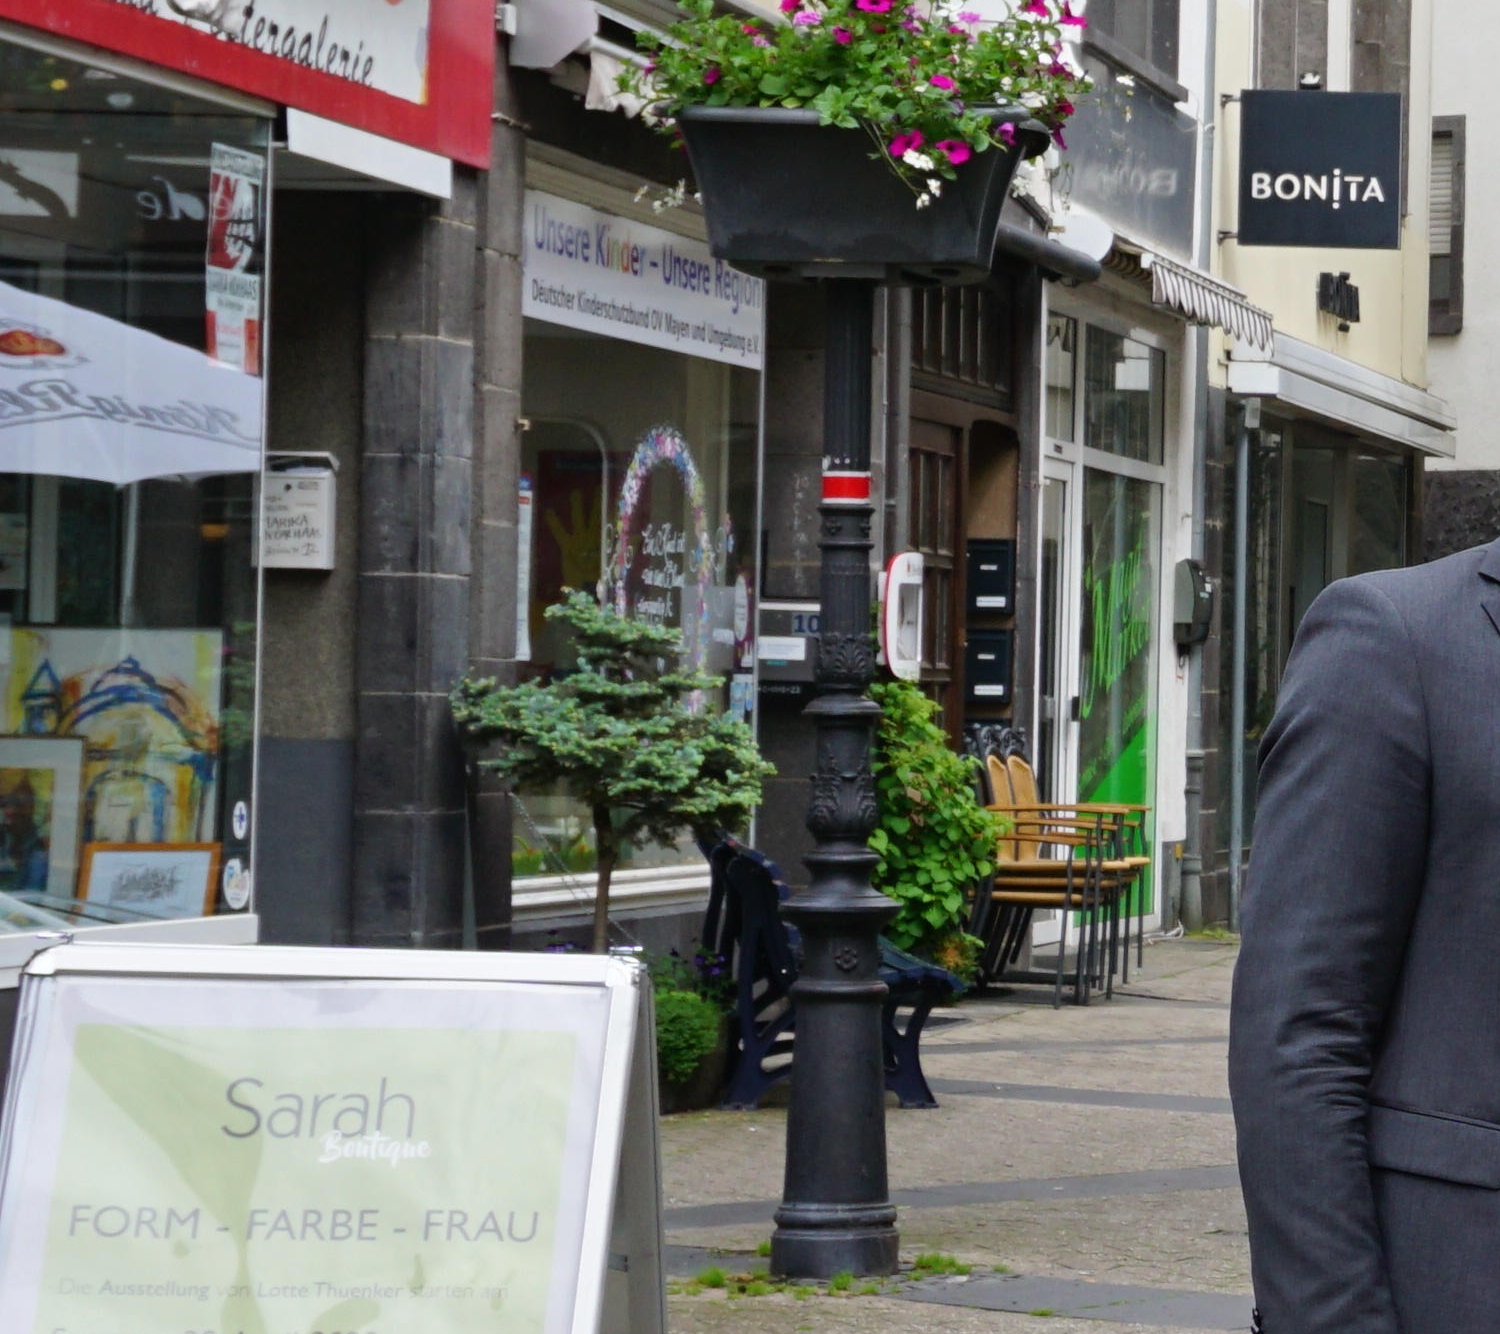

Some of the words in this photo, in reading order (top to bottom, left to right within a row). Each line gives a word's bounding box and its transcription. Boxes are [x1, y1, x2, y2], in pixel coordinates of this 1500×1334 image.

[533, 203, 591, 264] Unsere
[595, 222, 647, 278] Kinder
[661, 243, 710, 297] Unsere
[713, 259, 761, 316] Region
[531, 278, 575, 311] Deutscher
[576, 290, 650, 330] Kinderschutzbund
[651, 313, 663, 332] OV
[664, 314, 691, 342] Mayen
[692, 321, 706, 342] und
[707, 323, 747, 357] Umgebung
[221, 1077, 415, 1139] Sarah
[318, 1129, 432, 1168] Boutique
[68, 1204, 201, 1240] FORM
[246, 1208, 380, 1241] FARBE
[422, 1209, 540, 1243] FRAU
[58, 1277, 93, 1296] Die
[99, 1279, 210, 1302] Ausstellung
[216, 1283, 250, 1298] von
[257, 1281, 309, 1299] Lotte
[314, 1281, 403, 1299] Thuenker
[409, 1281, 474, 1299] starten
[480, 1287, 509, 1300] am
